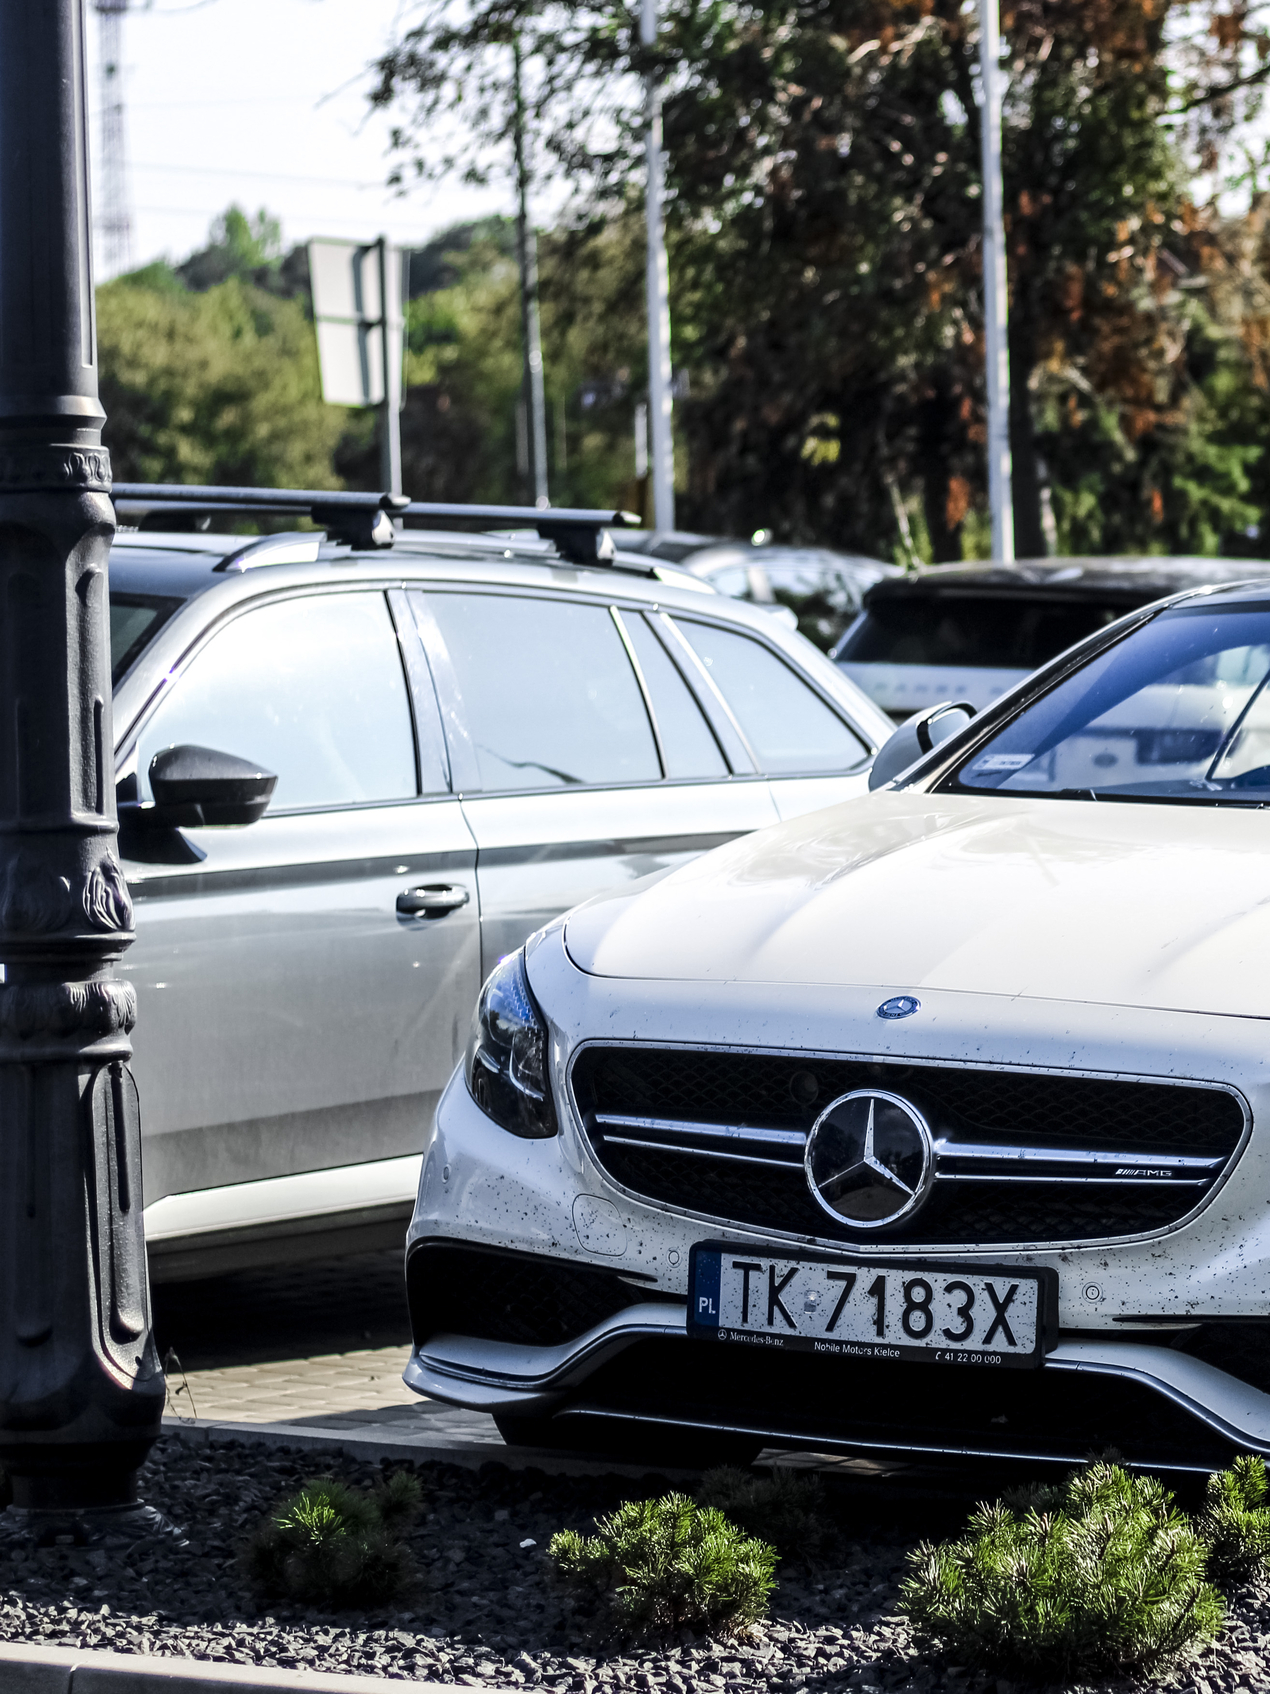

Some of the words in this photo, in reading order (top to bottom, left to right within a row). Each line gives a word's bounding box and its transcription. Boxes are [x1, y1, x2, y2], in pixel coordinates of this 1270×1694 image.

[1133, 1169, 1172, 1177] AMG
[699, 1297, 716, 1314] PL
[732, 1261, 800, 1329] TK
[825, 1270, 1019, 1346] 7183X
[729, 1331, 784, 1346] Mercedes-Benz
[814, 1341, 840, 1352] Nobile
[842, 1344, 872, 1355] Motors
[874, 1347, 900, 1357] Kielce
[944, 1353, 954, 1361] 41
[957, 1354, 968, 1363] 22
[971, 1354, 982, 1363] 00
[984, 1356, 1002, 1364] 000
